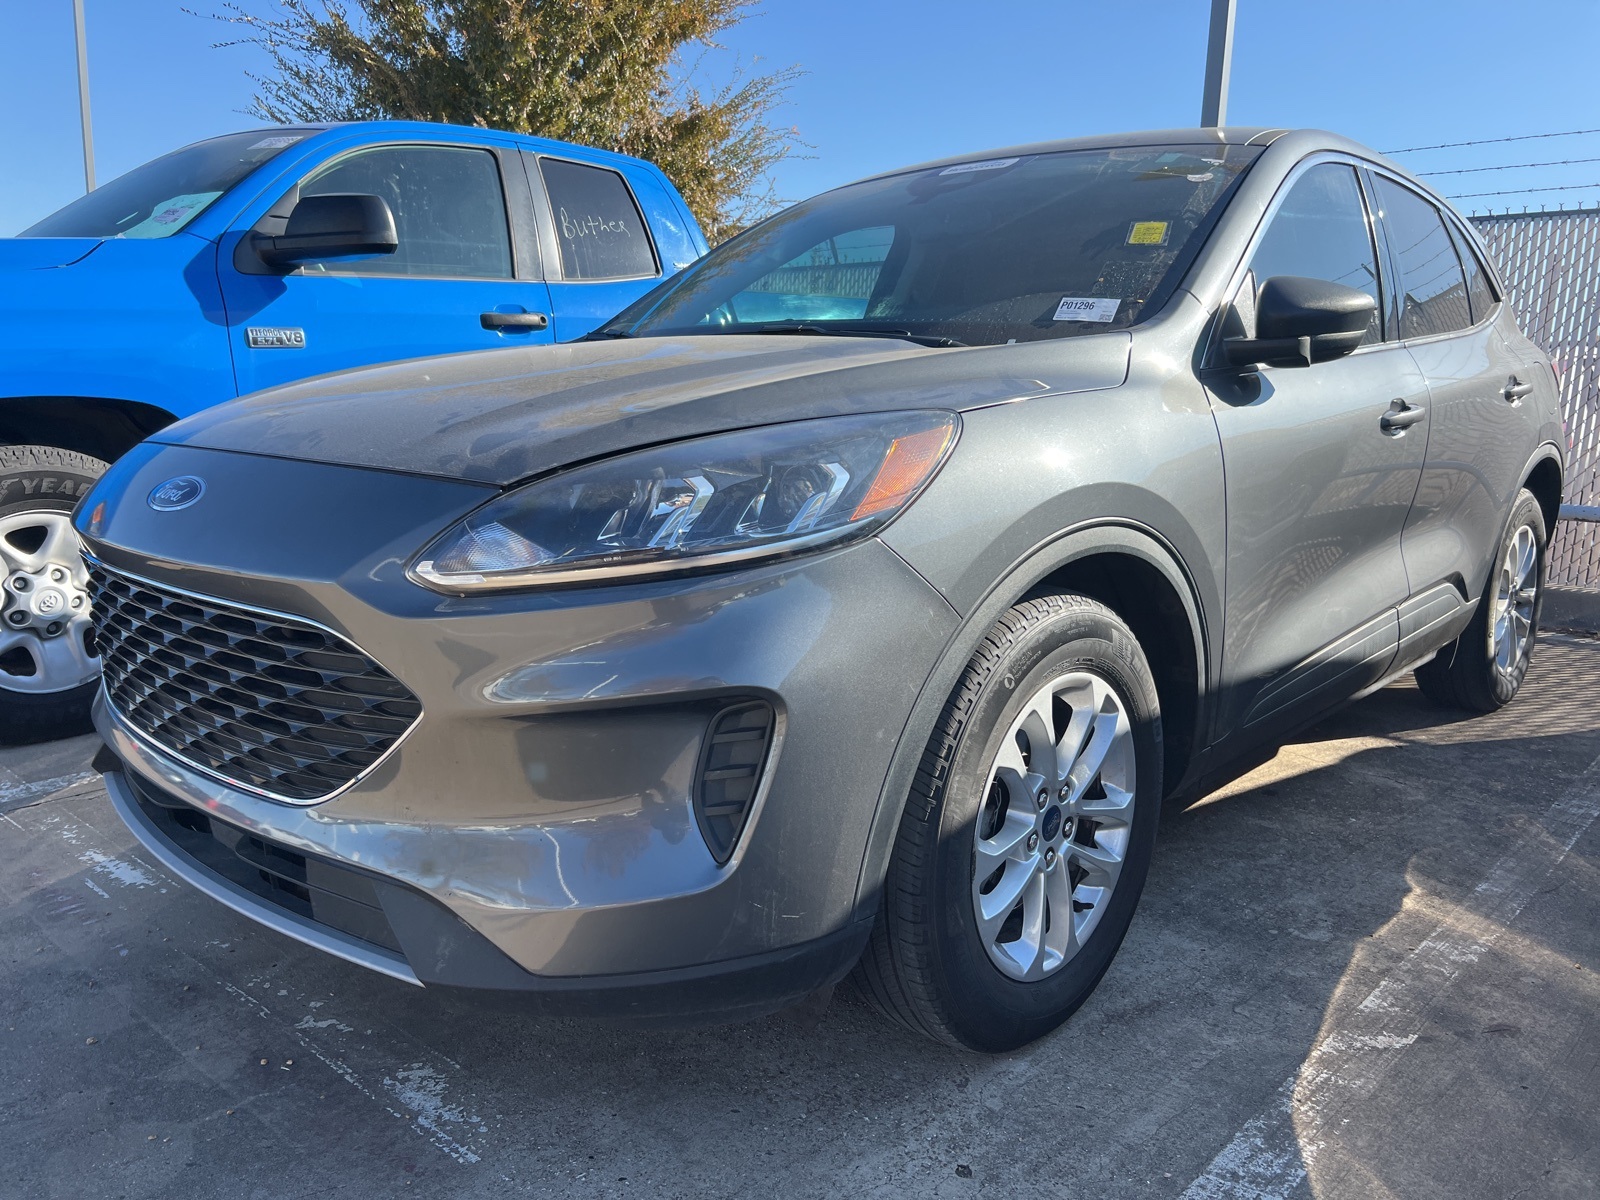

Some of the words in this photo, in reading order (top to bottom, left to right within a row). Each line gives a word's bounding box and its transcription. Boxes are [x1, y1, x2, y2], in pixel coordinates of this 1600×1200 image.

[1060, 301, 1096, 310] P01296
[282, 331, 304, 344] V8
[155, 480, 191, 502] Ford
